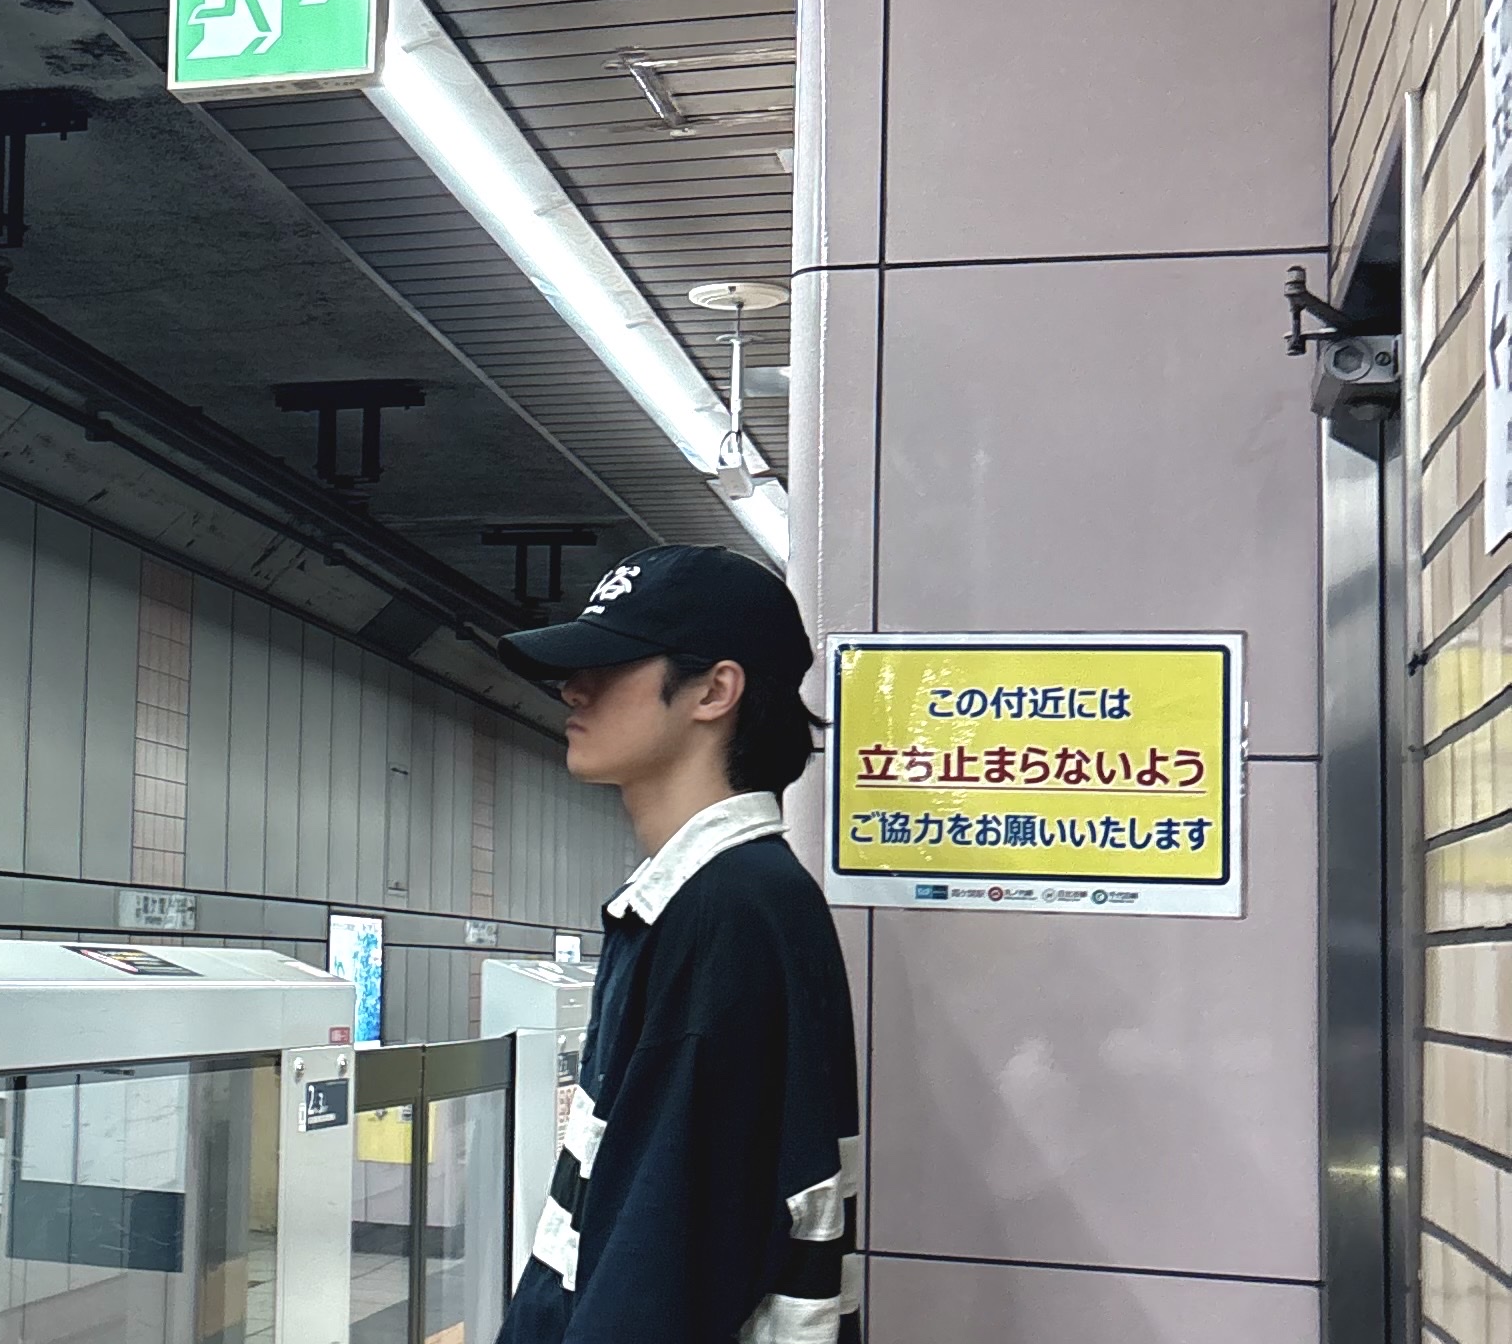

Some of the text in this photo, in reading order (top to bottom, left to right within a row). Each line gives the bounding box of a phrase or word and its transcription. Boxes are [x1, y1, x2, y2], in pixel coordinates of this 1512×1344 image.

[928, 686, 1132, 720] この付近には
[856, 743, 1206, 787] 立ち止まらないよう
[849, 811, 1213, 851] ご協力をお願いいたします
